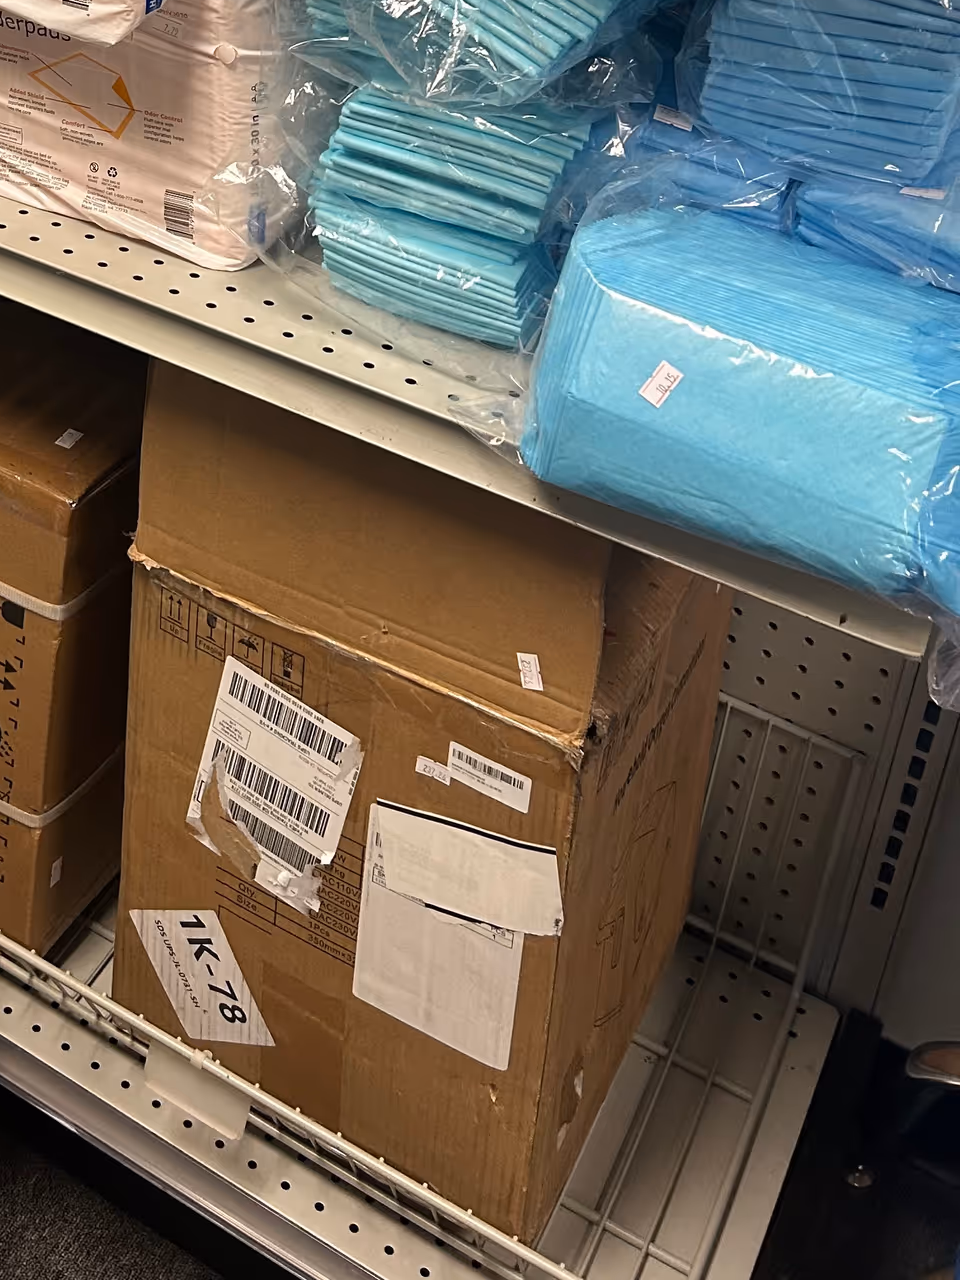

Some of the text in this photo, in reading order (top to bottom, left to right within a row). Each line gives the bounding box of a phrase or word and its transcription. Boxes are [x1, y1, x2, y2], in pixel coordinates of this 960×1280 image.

[62, 119, 85, 129] Comfort
[144, 110, 183, 123] Odor Control
[238, 882, 258, 898] Qty.
[154, 919, 168, 938] SDS
[308, 922, 330, 938] 1Pcs
[180, 914, 248, 1025] 1K-78
